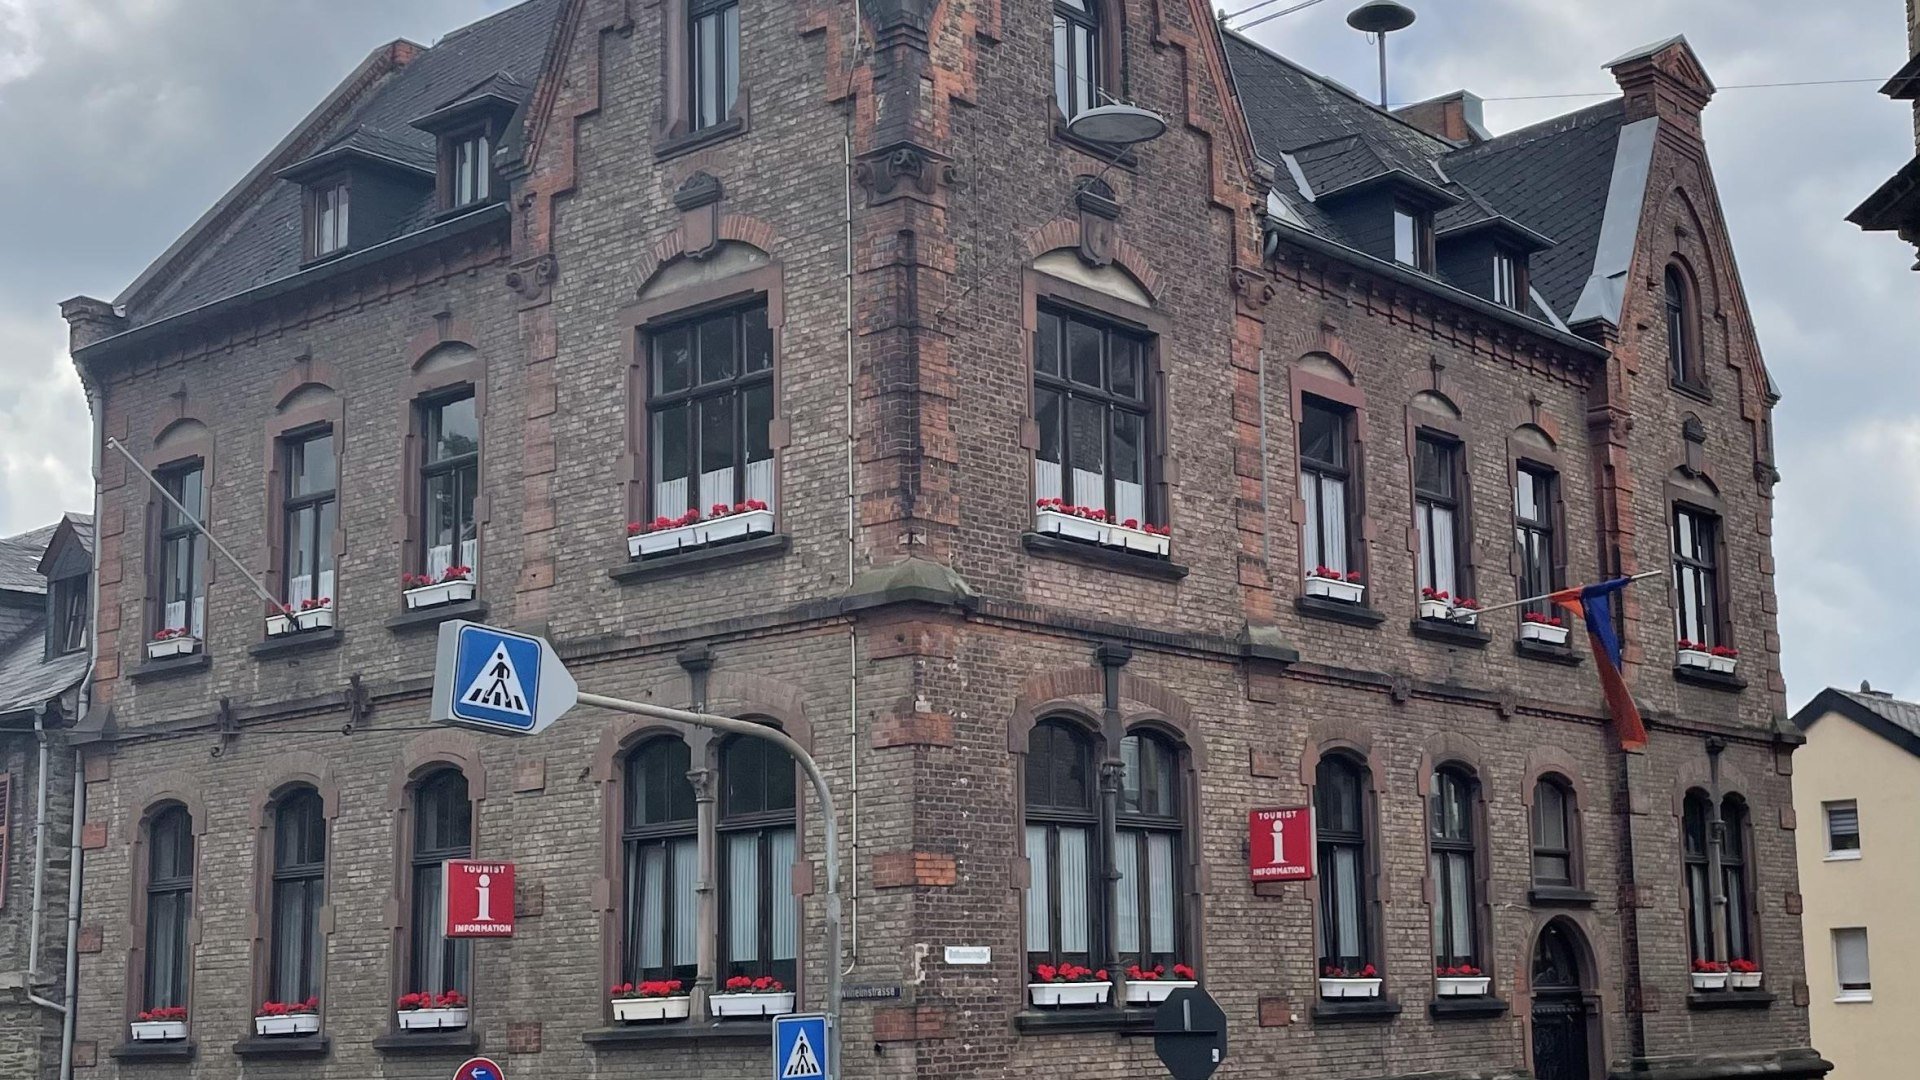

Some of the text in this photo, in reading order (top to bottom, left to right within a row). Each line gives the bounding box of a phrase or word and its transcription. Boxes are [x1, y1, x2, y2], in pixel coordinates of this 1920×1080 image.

[1258, 811, 1297, 820] TOURIST
[463, 865, 505, 874] TOURIST
[1253, 866, 1305, 876] INFORMATION
[455, 924, 512, 933] INFORMATION
